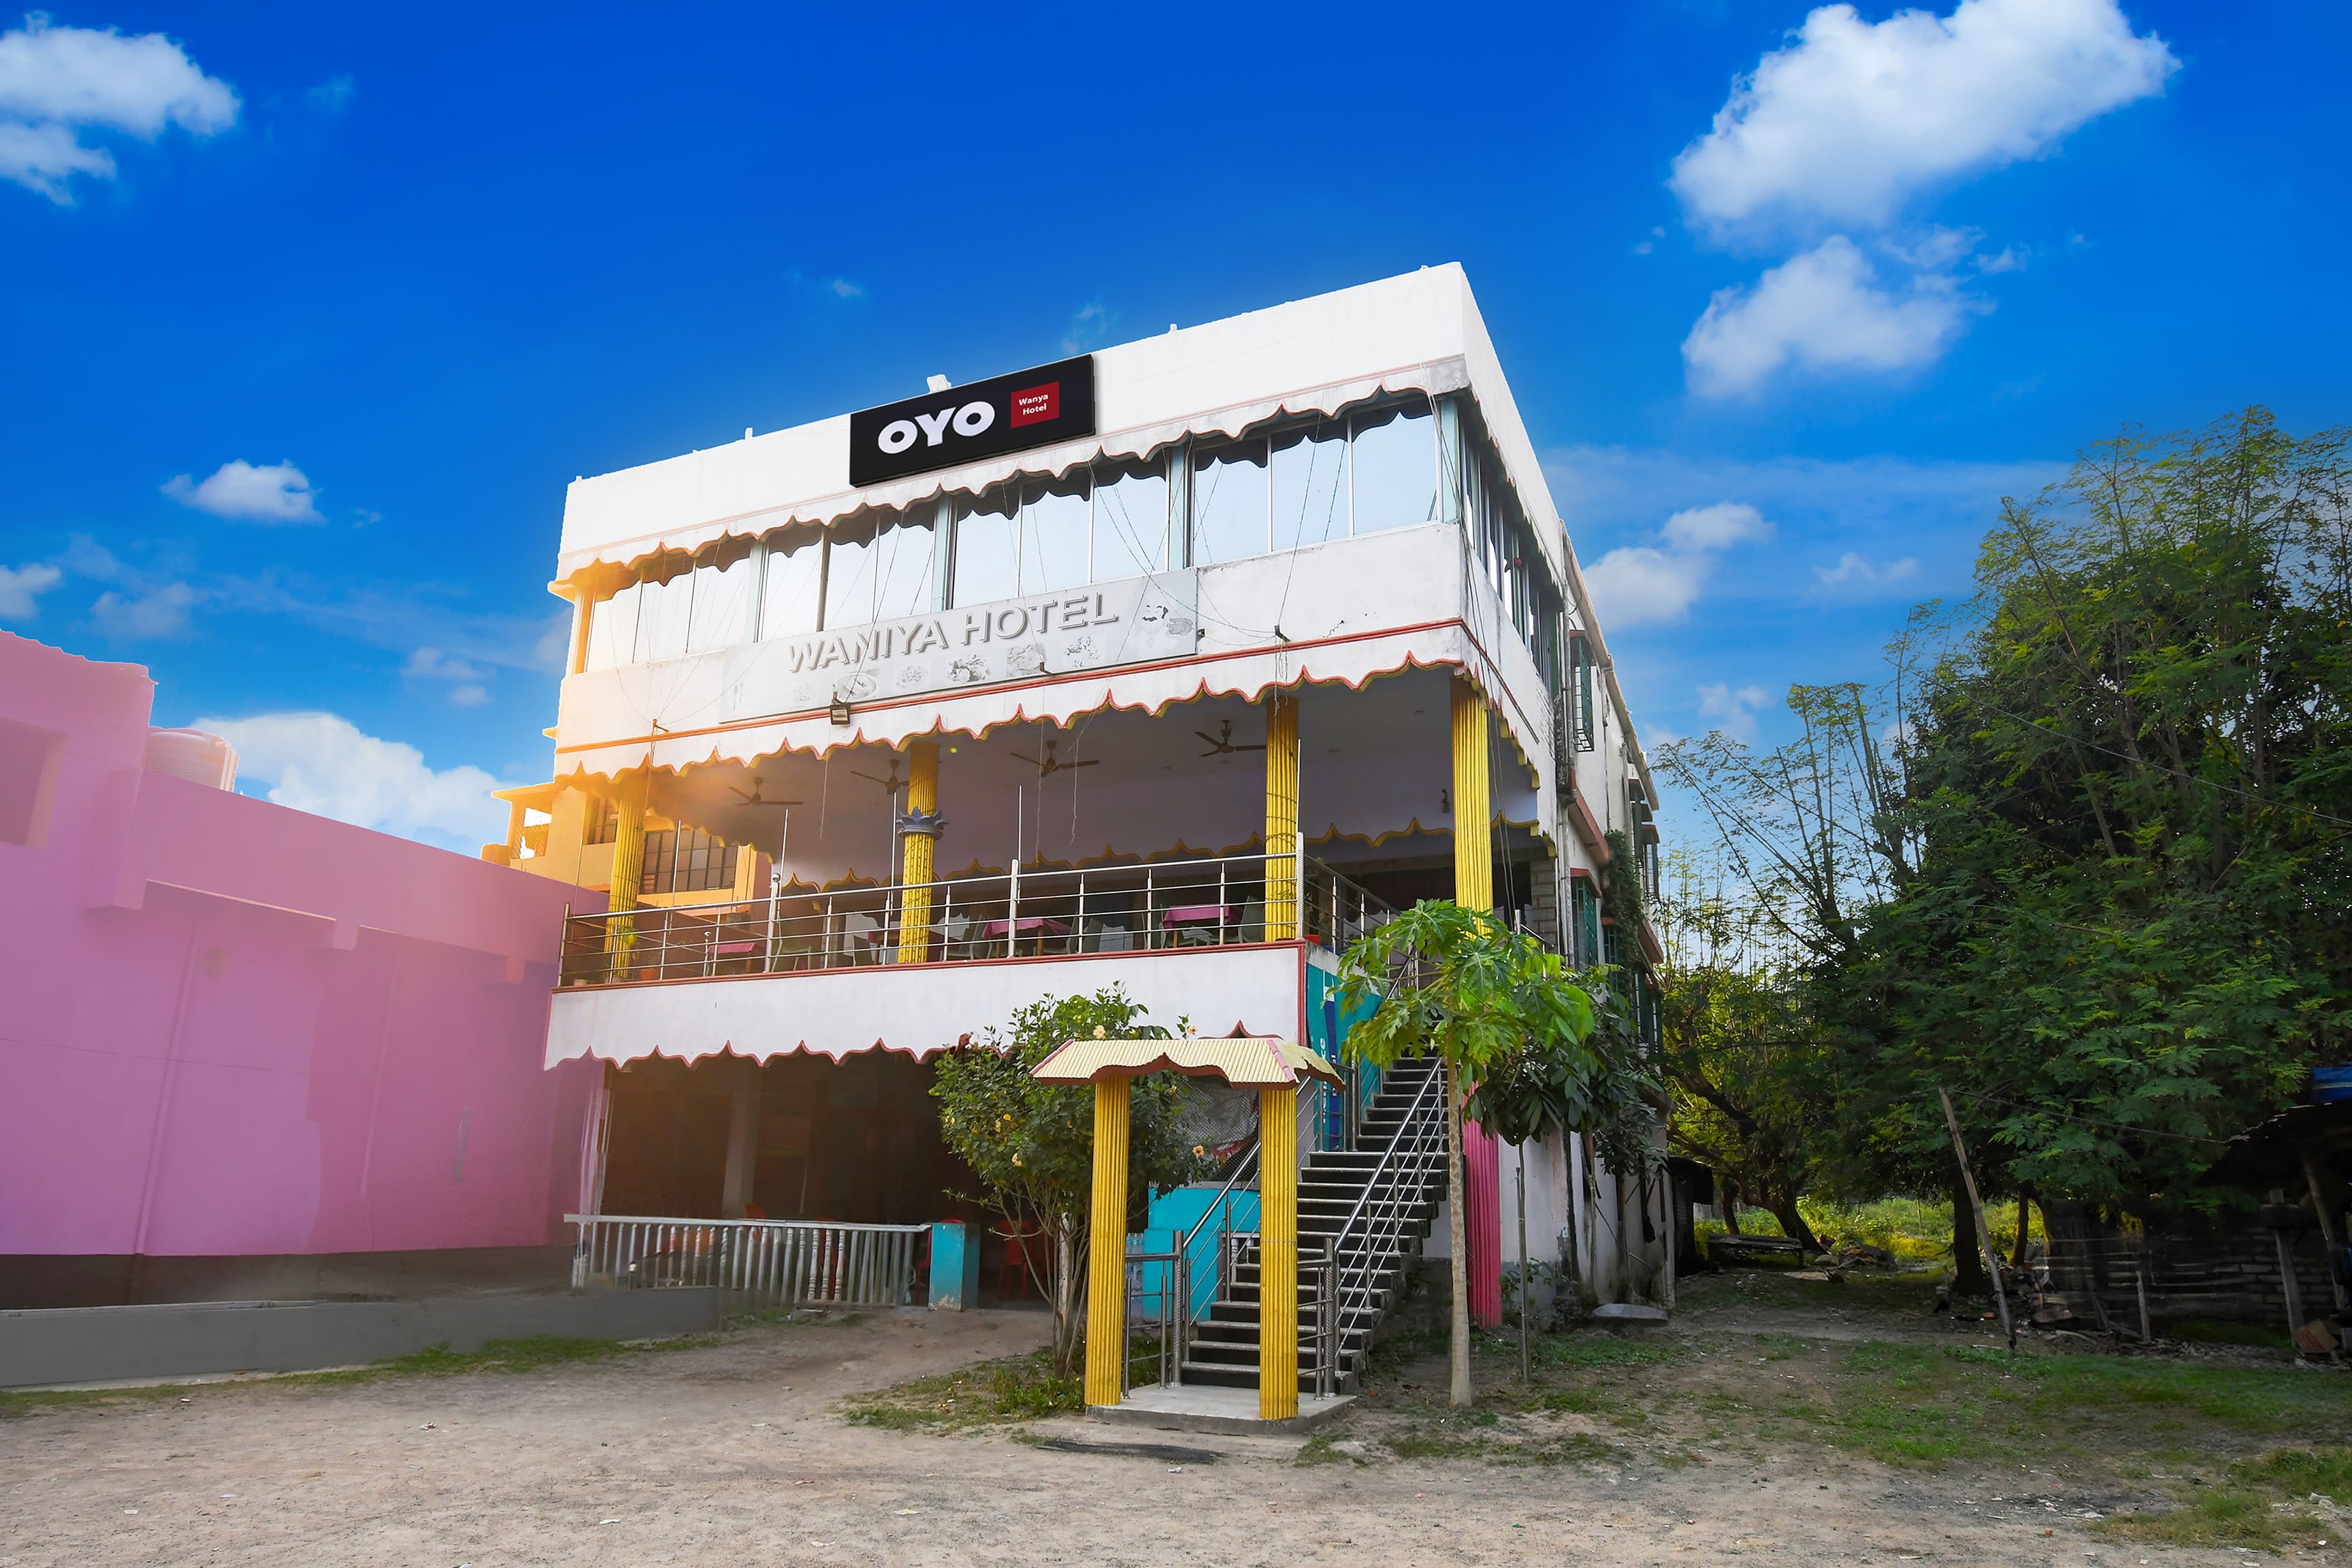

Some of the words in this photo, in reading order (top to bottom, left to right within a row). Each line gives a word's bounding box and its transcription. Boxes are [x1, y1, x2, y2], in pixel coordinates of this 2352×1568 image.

[1019, 394, 1049, 406] Wanya
[1023, 403, 1047, 415] Hotel
[878, 401, 995, 454] OYO
[960, 591, 1120, 646] HOTEL
